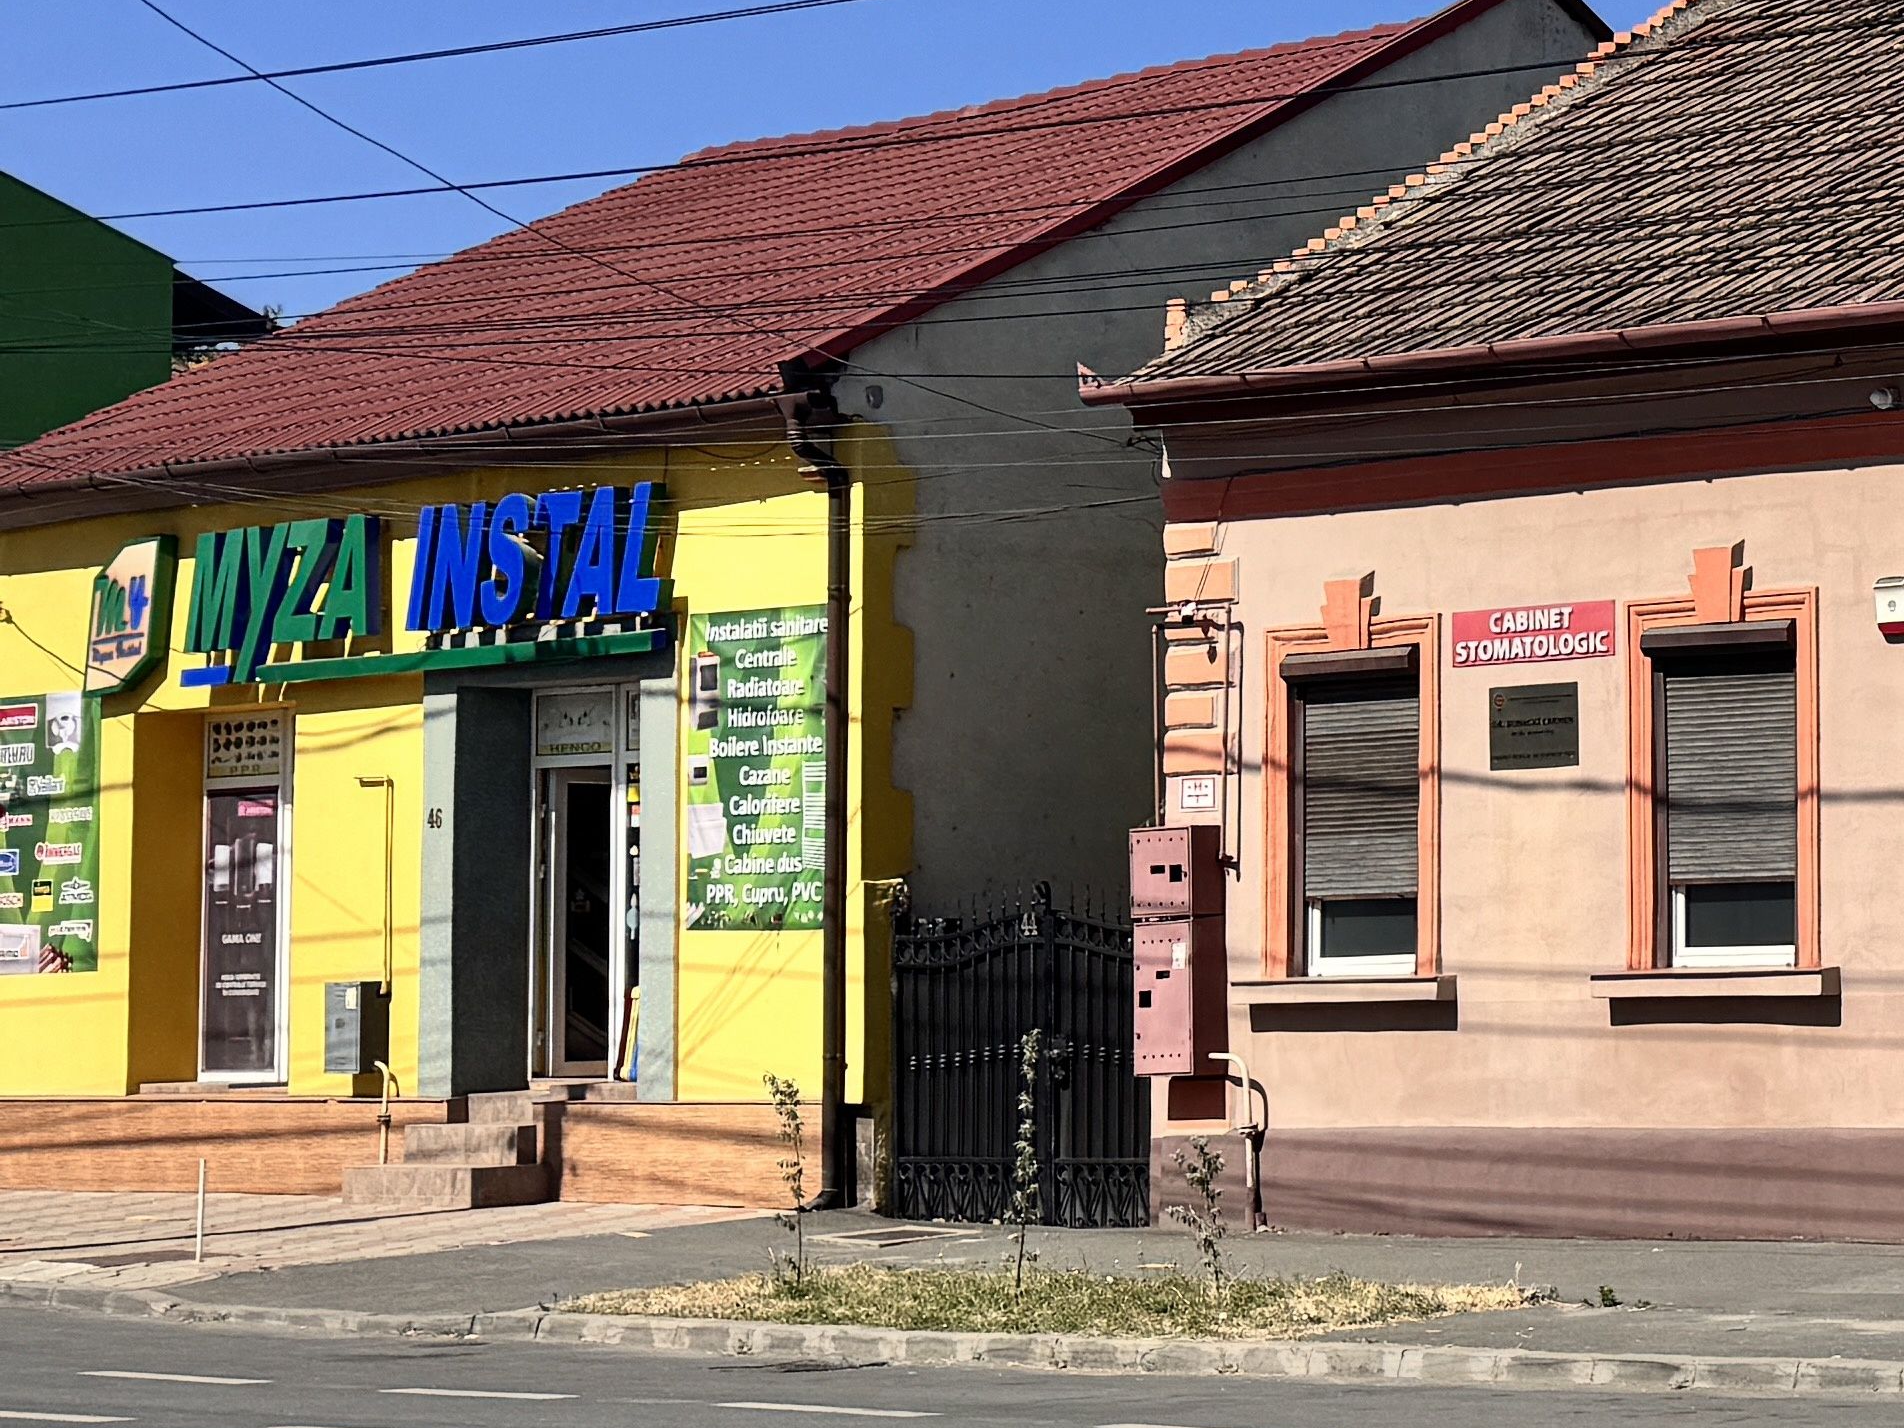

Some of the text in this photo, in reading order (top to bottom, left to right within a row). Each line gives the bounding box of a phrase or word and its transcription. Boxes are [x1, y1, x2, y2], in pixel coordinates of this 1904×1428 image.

[184, 481, 661, 684] MYZA INSTAL
[770, 615, 828, 637] sanitare
[1489, 607, 1573, 633] CABINET
[735, 646, 798, 669] Centrale
[1455, 631, 1609, 663] STOMATOLOGIC
[727, 676, 805, 699] Radiatoare
[727, 704, 804, 728] Hidrofoare
[709, 733, 823, 758] Boilere Instante
[739, 766, 791, 786] Cazane
[729, 793, 801, 816] Calorifere
[427, 808, 443, 829] 46
[733, 823, 797, 845] Chiuvete
[725, 852, 803, 874] Cabine dus
[706, 881, 823, 908] PPR, Cupru, PVC
